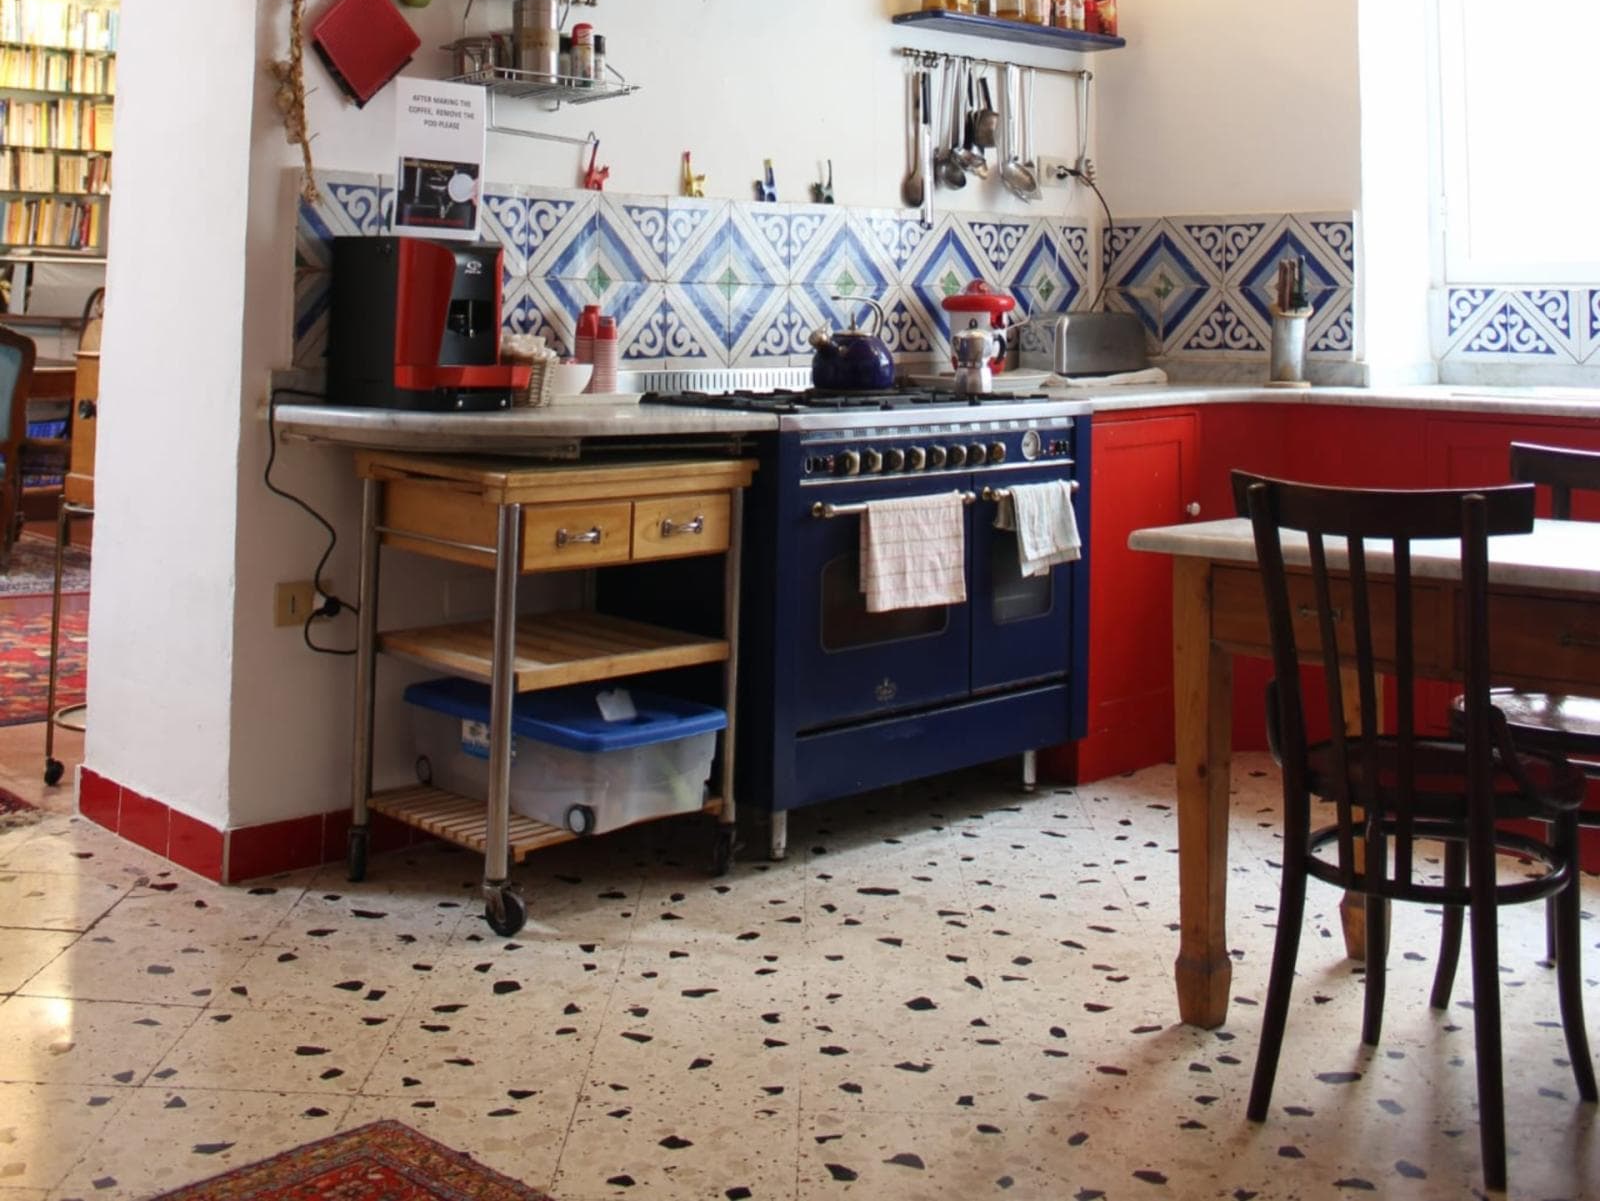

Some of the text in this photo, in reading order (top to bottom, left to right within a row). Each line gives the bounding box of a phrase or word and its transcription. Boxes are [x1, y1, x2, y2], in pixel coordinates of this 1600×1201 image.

[412, 94, 472, 108] AFTER MAKING THE
[436, 108, 462, 118] REMOVE
[463, 111, 475, 120] THE
[438, 120, 460, 130] PLEASE
